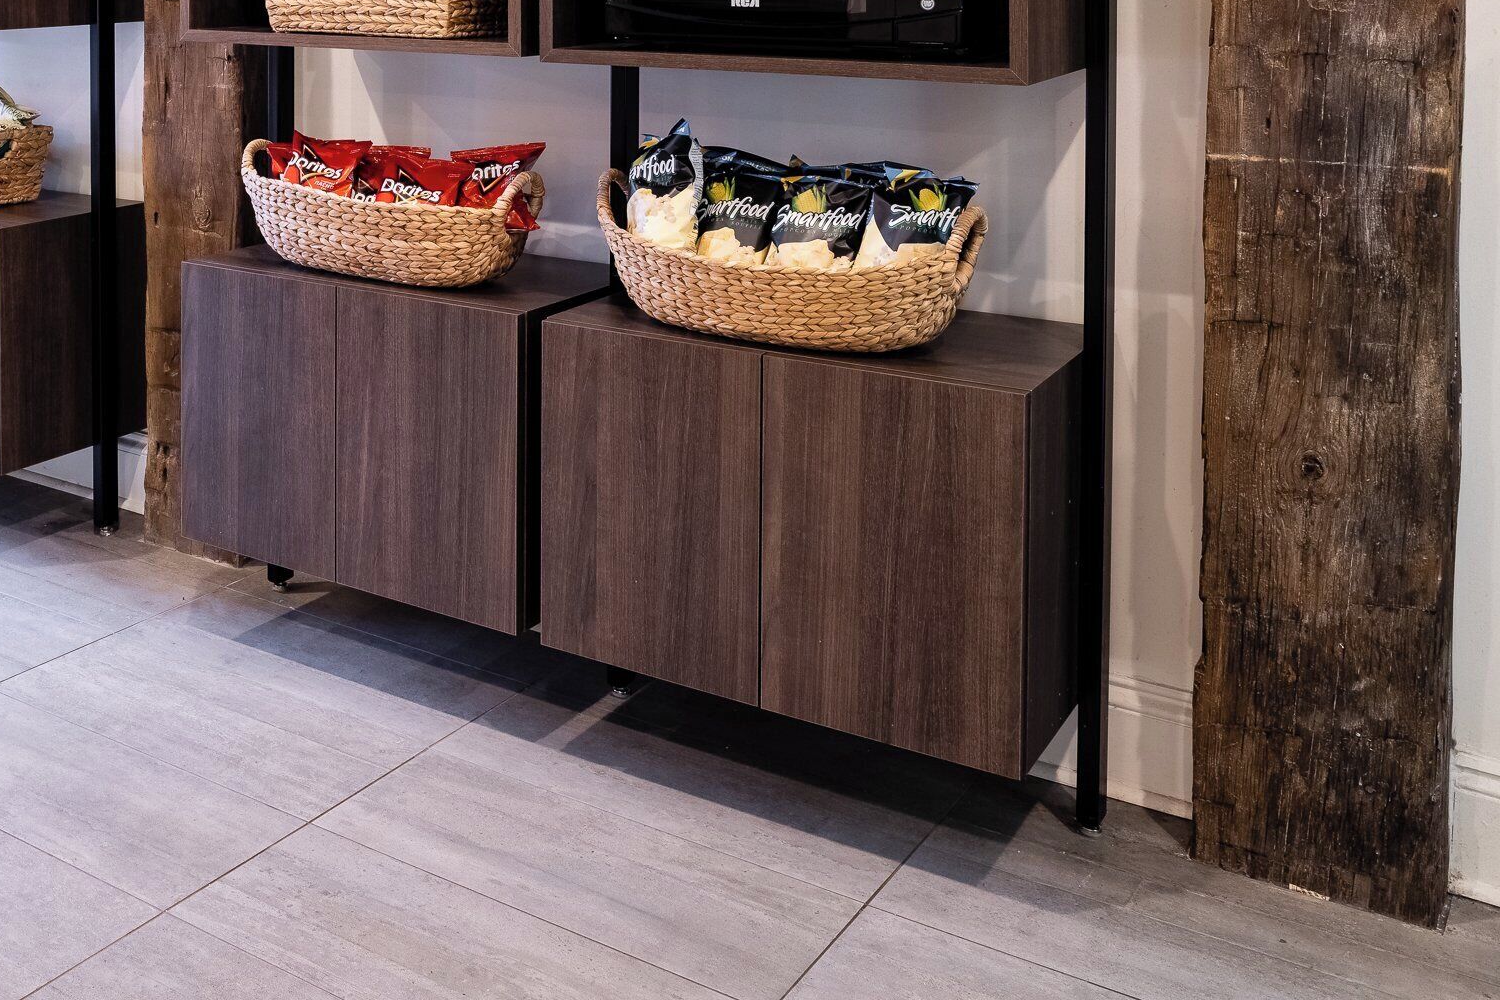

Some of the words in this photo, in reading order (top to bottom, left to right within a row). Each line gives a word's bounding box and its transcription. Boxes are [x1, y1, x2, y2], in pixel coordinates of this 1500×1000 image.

[289, 151, 344, 179] Doritos
[381, 178, 443, 203] Doritos
[698, 197, 774, 221] Smartfood
[772, 205, 866, 233] Smartfood
